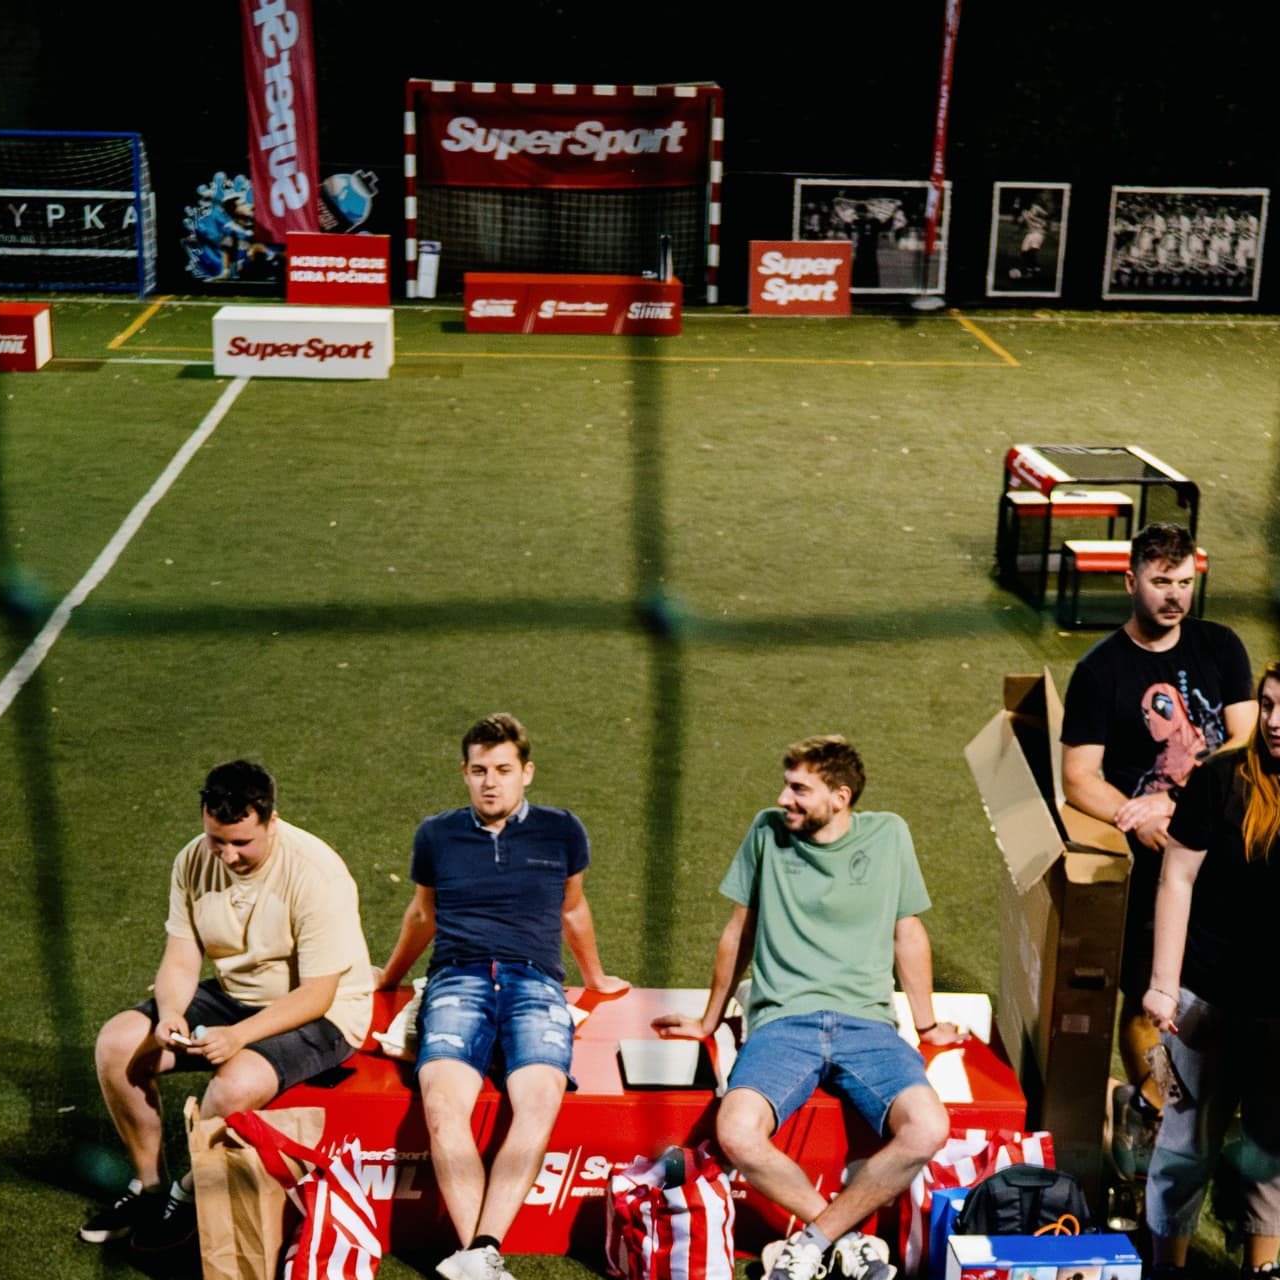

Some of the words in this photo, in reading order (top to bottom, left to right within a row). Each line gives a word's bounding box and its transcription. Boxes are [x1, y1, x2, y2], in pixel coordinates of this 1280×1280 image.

[441, 117, 687, 161] SuperSport
[757, 251, 843, 279] Super
[761, 278, 838, 305] Sport
[227, 337, 373, 362] SuperSport
